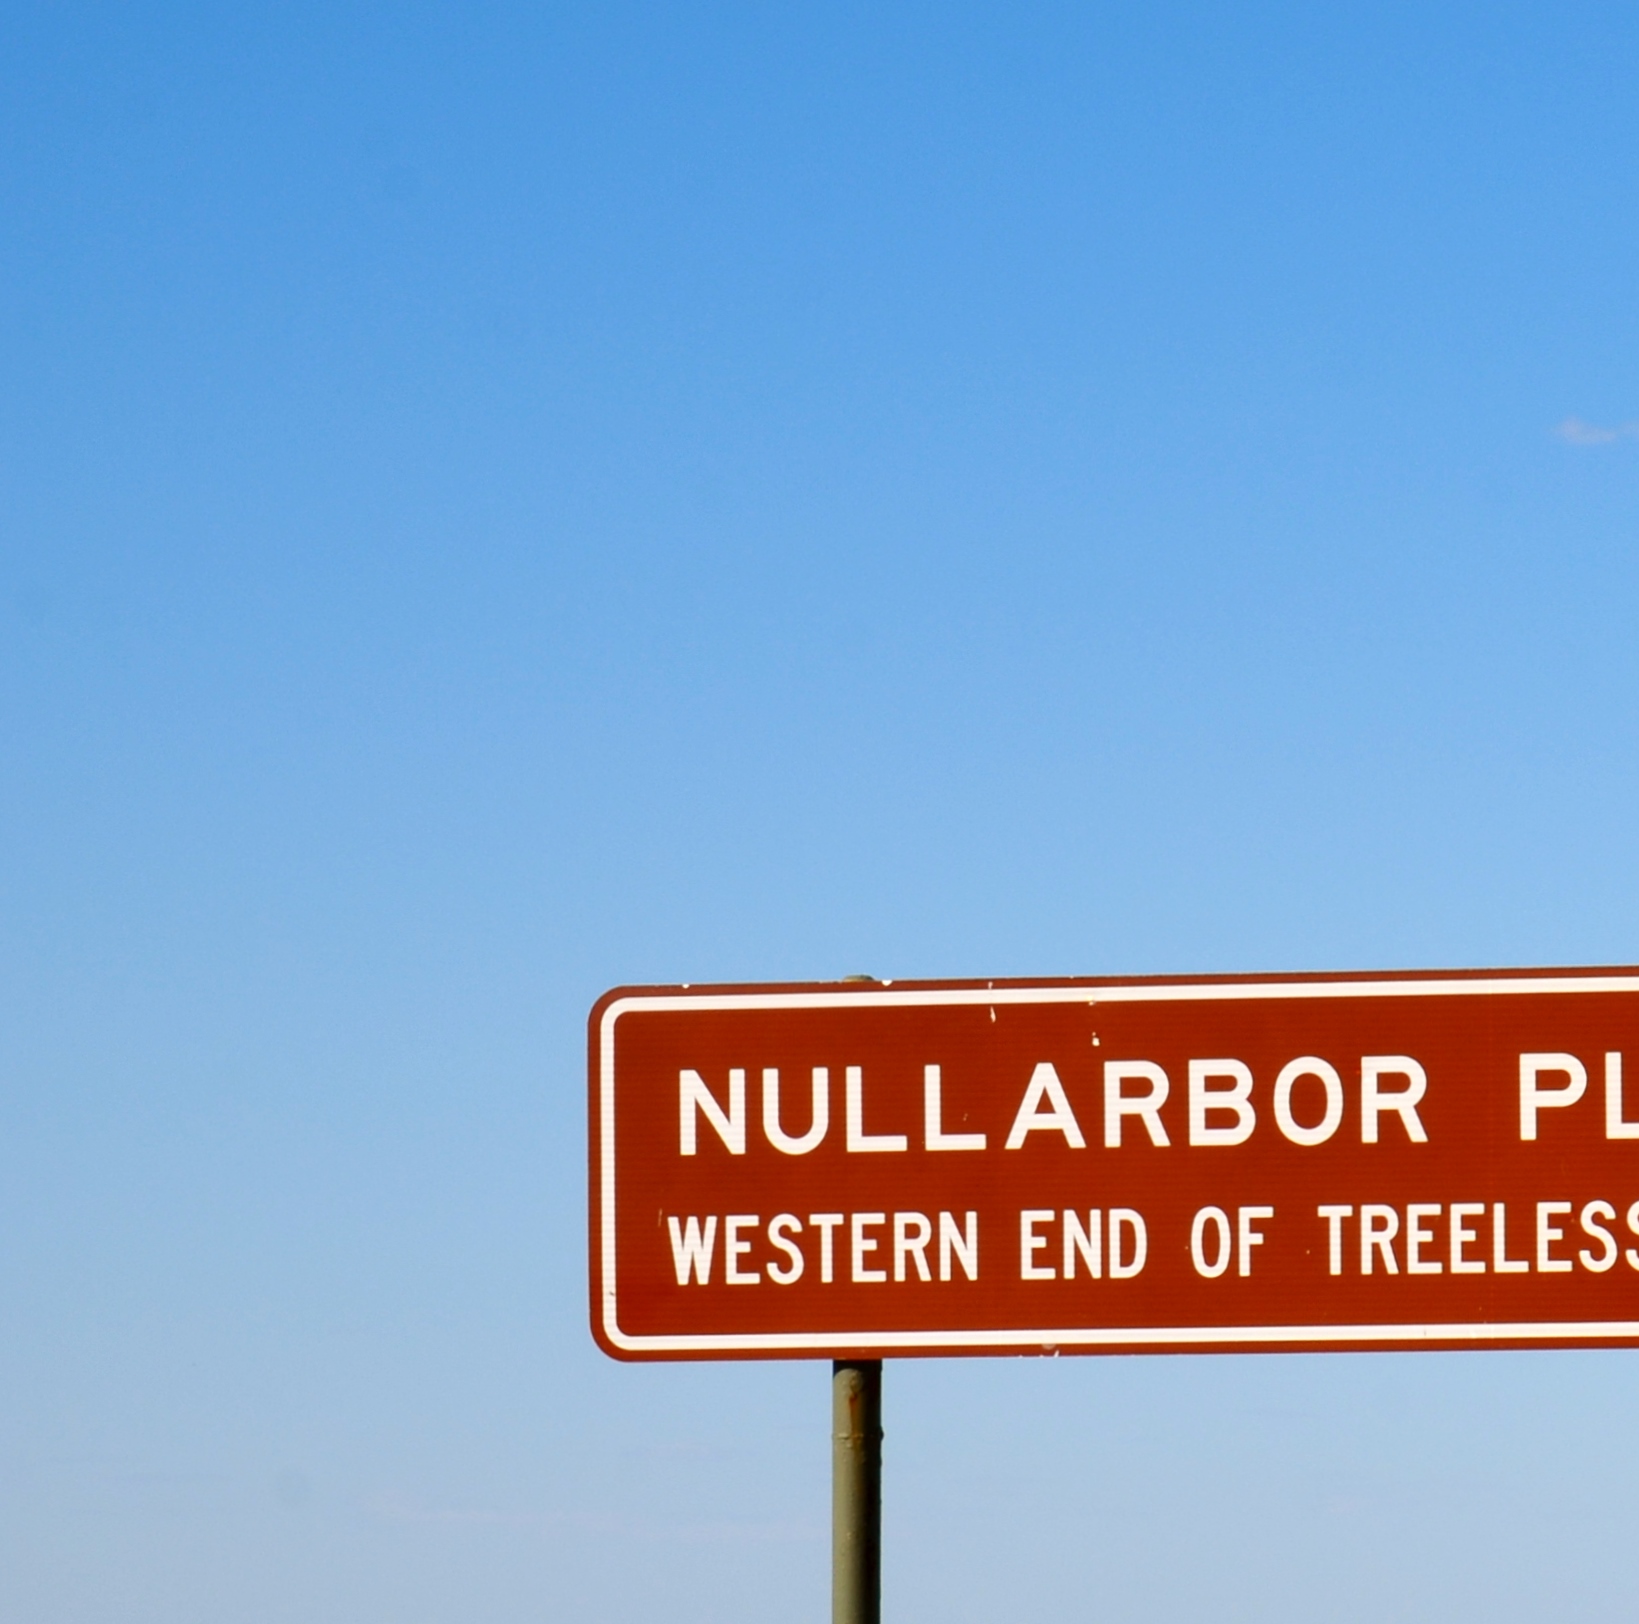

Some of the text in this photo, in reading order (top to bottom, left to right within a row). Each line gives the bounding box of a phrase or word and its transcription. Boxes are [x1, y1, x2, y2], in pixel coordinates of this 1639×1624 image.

[679, 1055, 1428, 1156] NULLARBOR
[667, 1210, 978, 1285] WESTERN
[1020, 1208, 1148, 1280] END
[1190, 1205, 1274, 1278] OF
